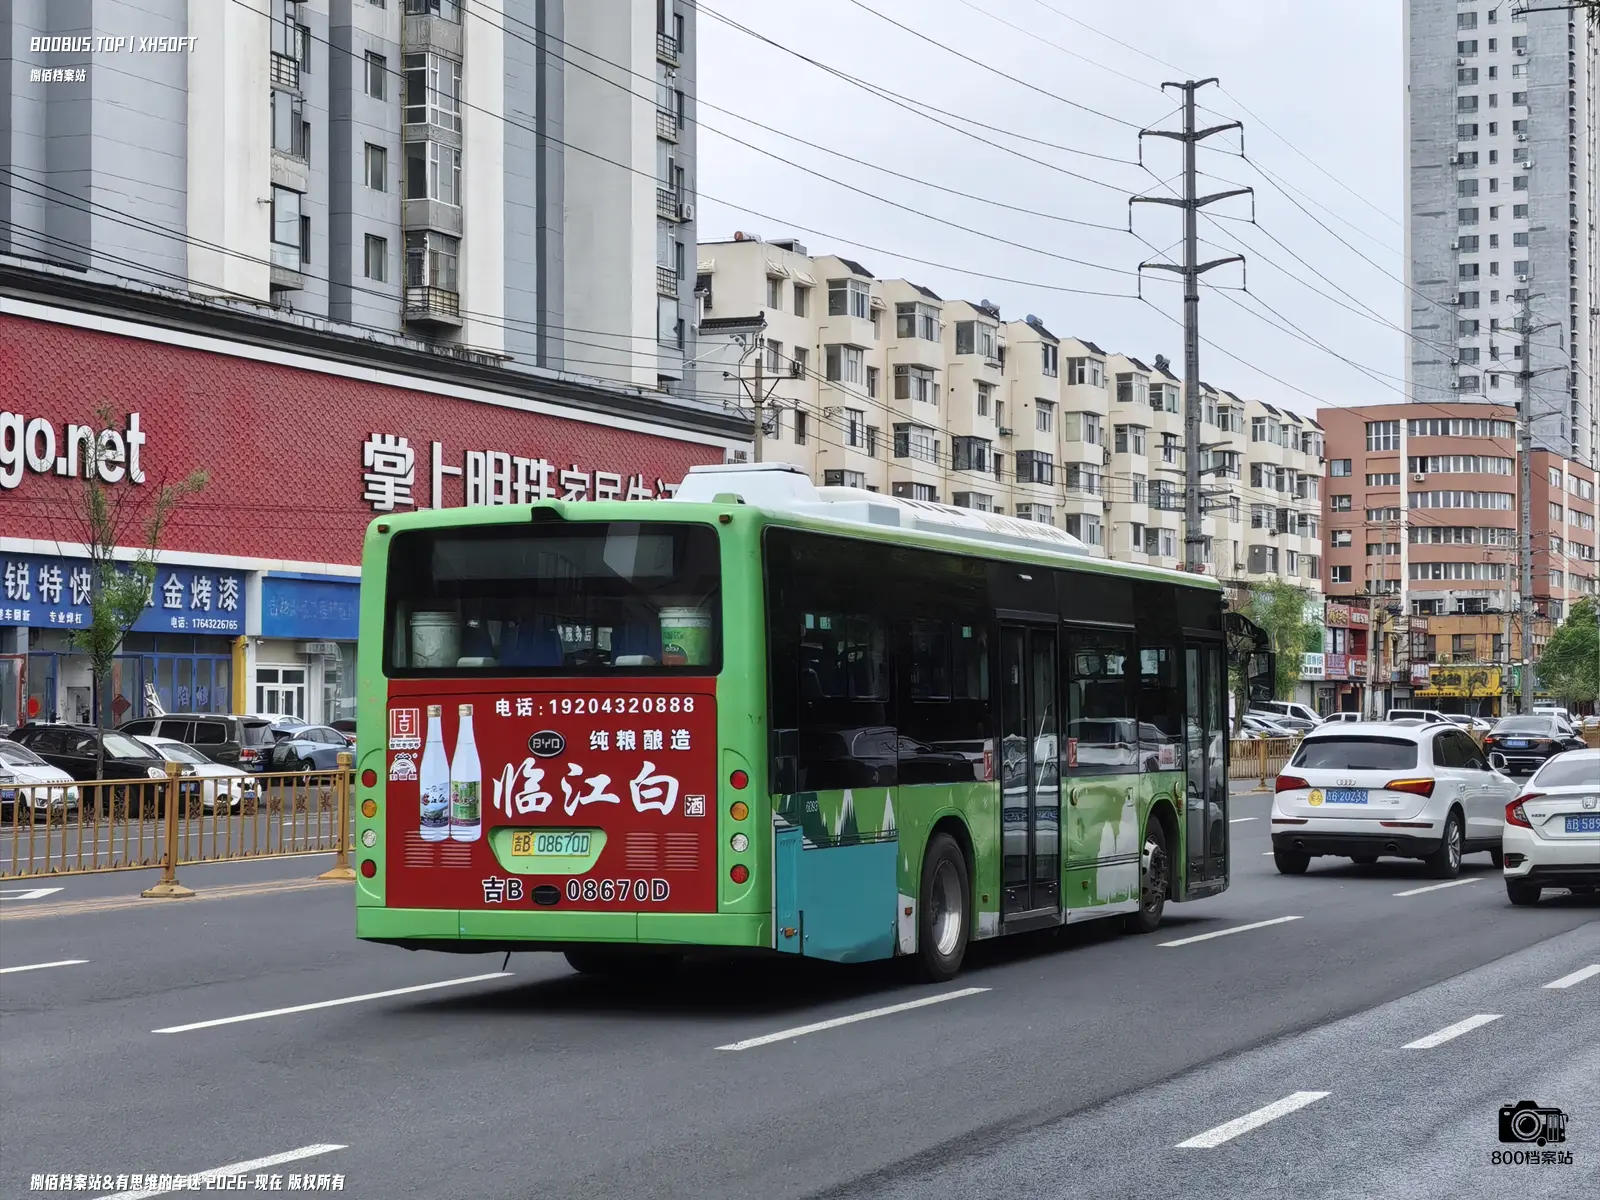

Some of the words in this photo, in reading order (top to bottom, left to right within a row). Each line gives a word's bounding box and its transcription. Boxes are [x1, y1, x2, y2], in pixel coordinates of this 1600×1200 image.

[0, 411, 146, 488] go.net
[4, 561, 239, 612] 锐特快金烤漆
[532, 738, 560, 749] BYD
[589, 729, 691, 751] 纯粮酿造
[493, 757, 679, 818] 临江白
[684, 795, 706, 817] 酒
[537, 835, 590, 853] 08670D
[482, 876, 524, 903] 吉B
[566, 878, 670, 902] 08670D
